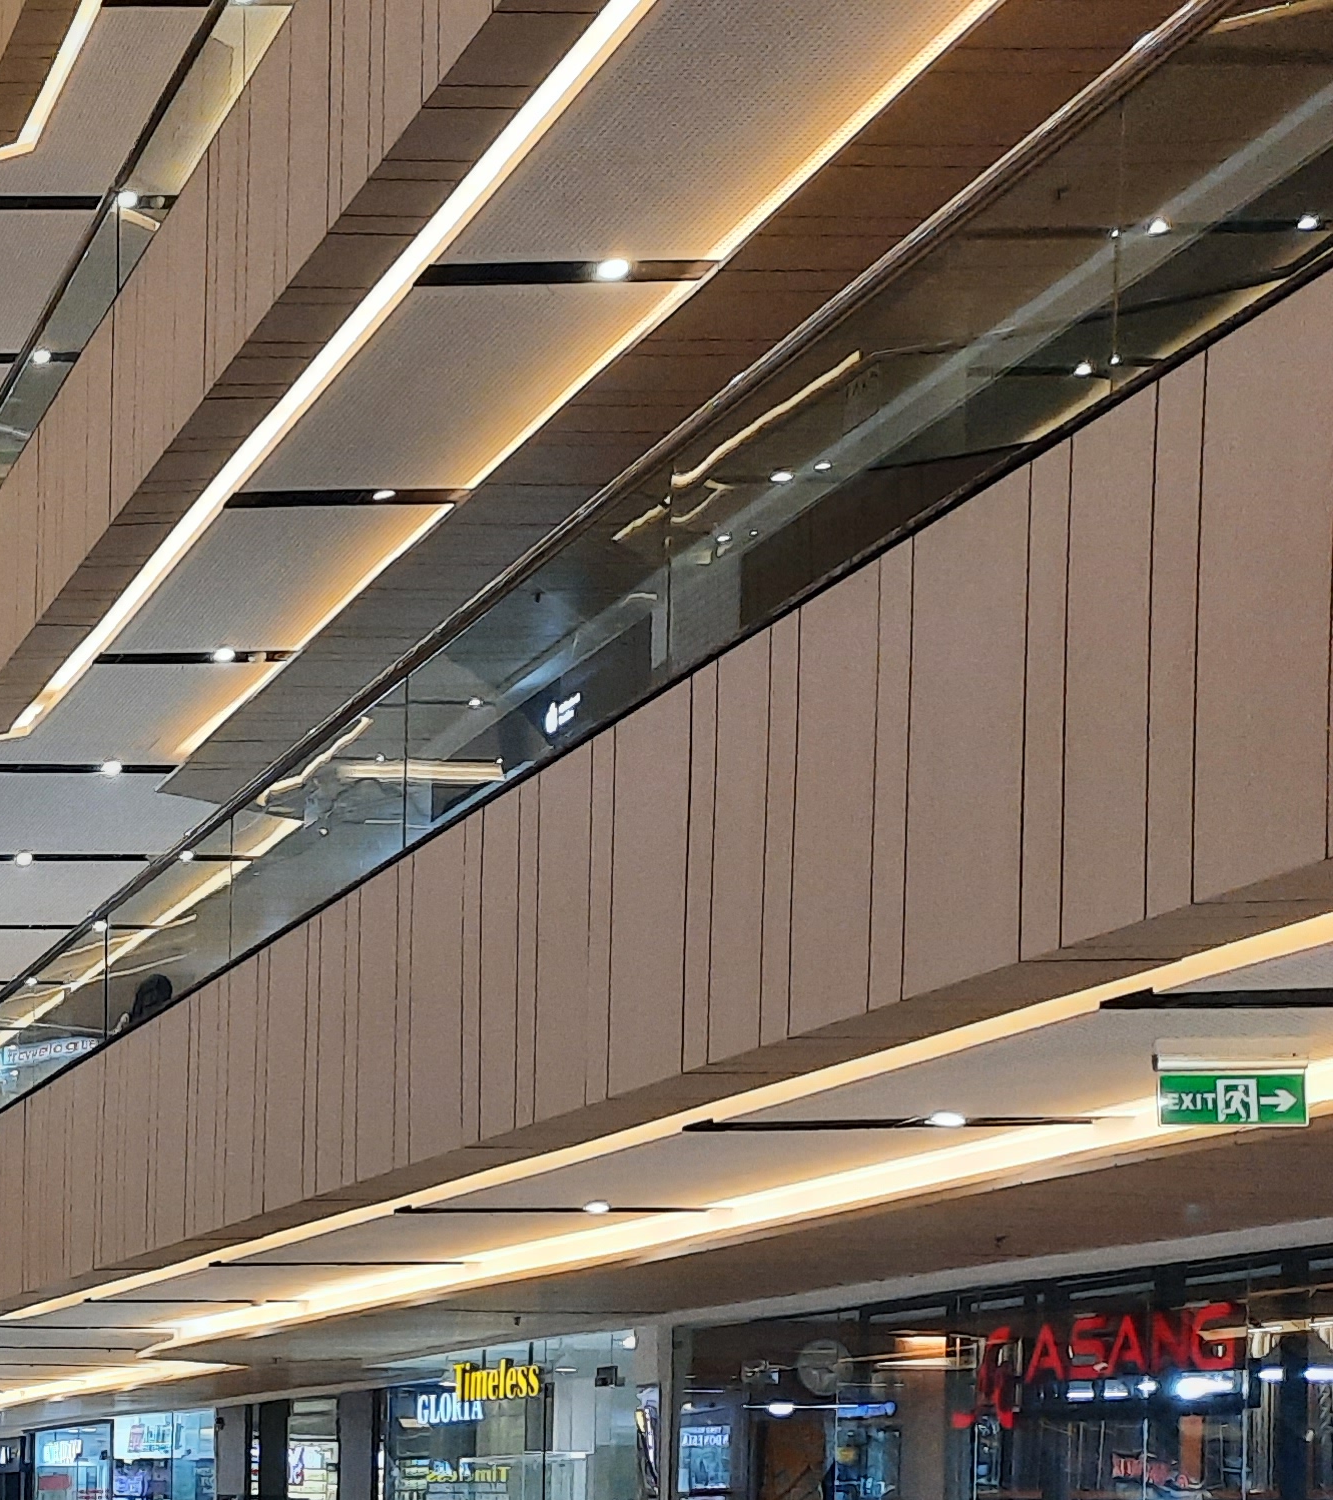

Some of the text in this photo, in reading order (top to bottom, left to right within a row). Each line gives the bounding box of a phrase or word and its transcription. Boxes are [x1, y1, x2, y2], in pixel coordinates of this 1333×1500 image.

[1167, 1092, 1216, 1111] EXIT
[454, 1358, 540, 1401] Timeless
[417, 1393, 484, 1424] GLORIA
